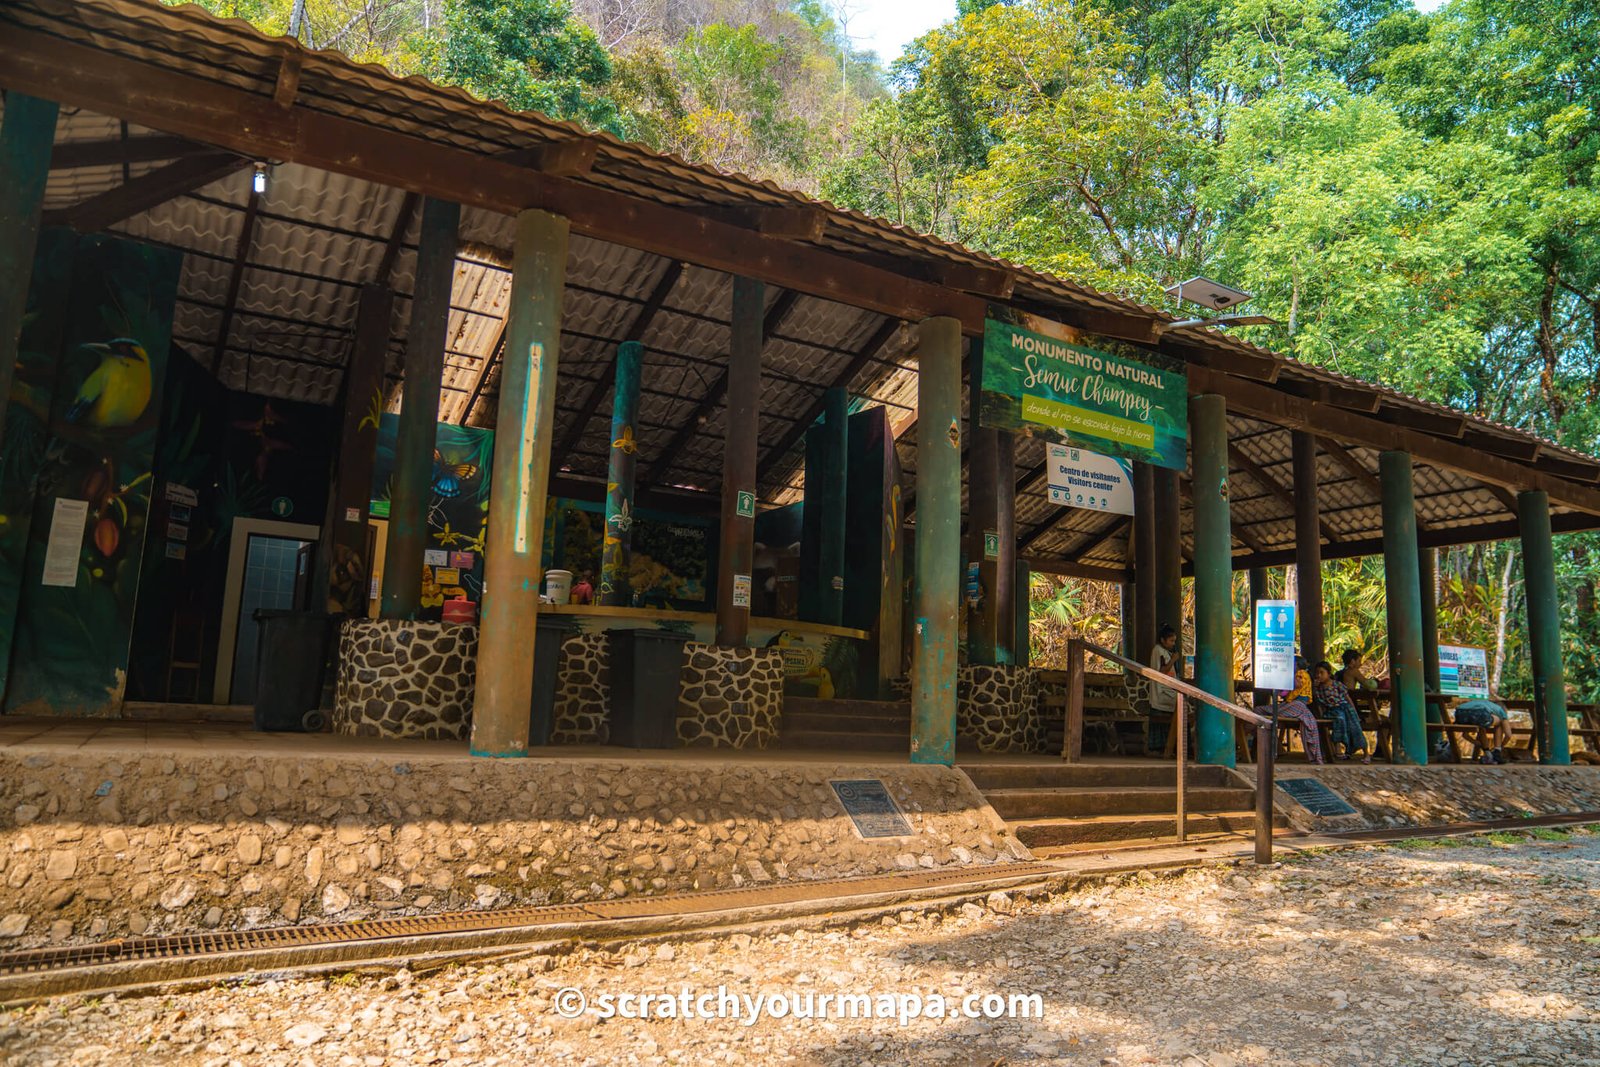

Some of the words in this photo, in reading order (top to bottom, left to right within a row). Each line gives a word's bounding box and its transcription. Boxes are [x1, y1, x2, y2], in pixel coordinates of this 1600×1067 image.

[1011, 333, 1103, 372] MONUMENTO
[1105, 361, 1165, 390] NATURAL
[1023, 354, 1080, 394] Semuc
[1081, 375, 1153, 421] Champey
[1026, 403, 1051, 417] donde
[1051, 407, 1060, 418] el
[1072, 415, 1081, 424] se
[1082, 417, 1110, 432] esconde
[1111, 421, 1125, 436] bajo
[1125, 425, 1133, 437] la
[1133, 427, 1152, 442] tierra
[1059, 465, 1081, 477] Centro
[1081, 469, 1090, 478] de
[1090, 471, 1121, 484] visitantes
[1067, 476, 1092, 488] Visitors
[1092, 482, 1114, 491] center
